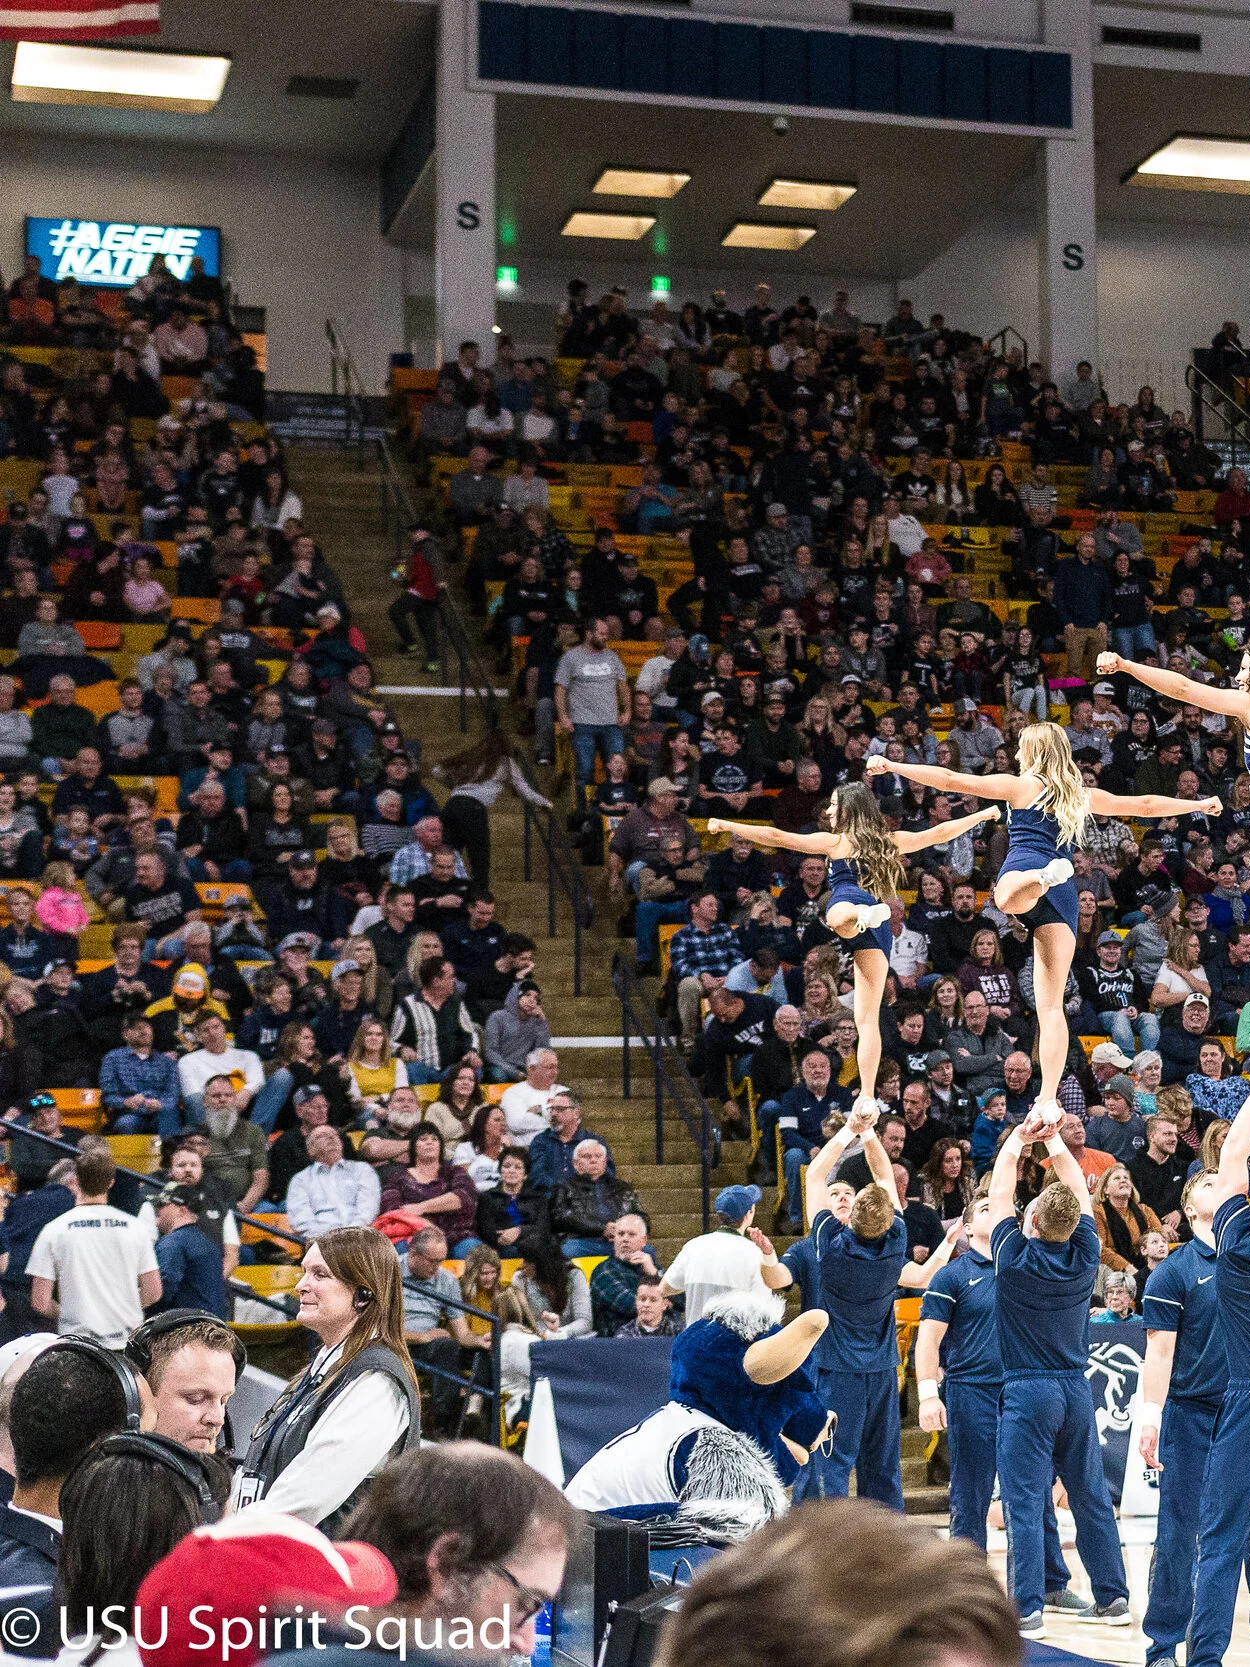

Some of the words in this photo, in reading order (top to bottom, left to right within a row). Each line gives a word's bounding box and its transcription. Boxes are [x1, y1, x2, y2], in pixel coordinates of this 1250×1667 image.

[457, 201, 480, 230] S
[49, 220, 202, 256] #AGGIE
[56, 248, 194, 281] NATIN
[1063, 244, 1084, 271] S
[67, 1219, 101, 1230] PROMO
[105, 1218, 129, 1229] TEAM
